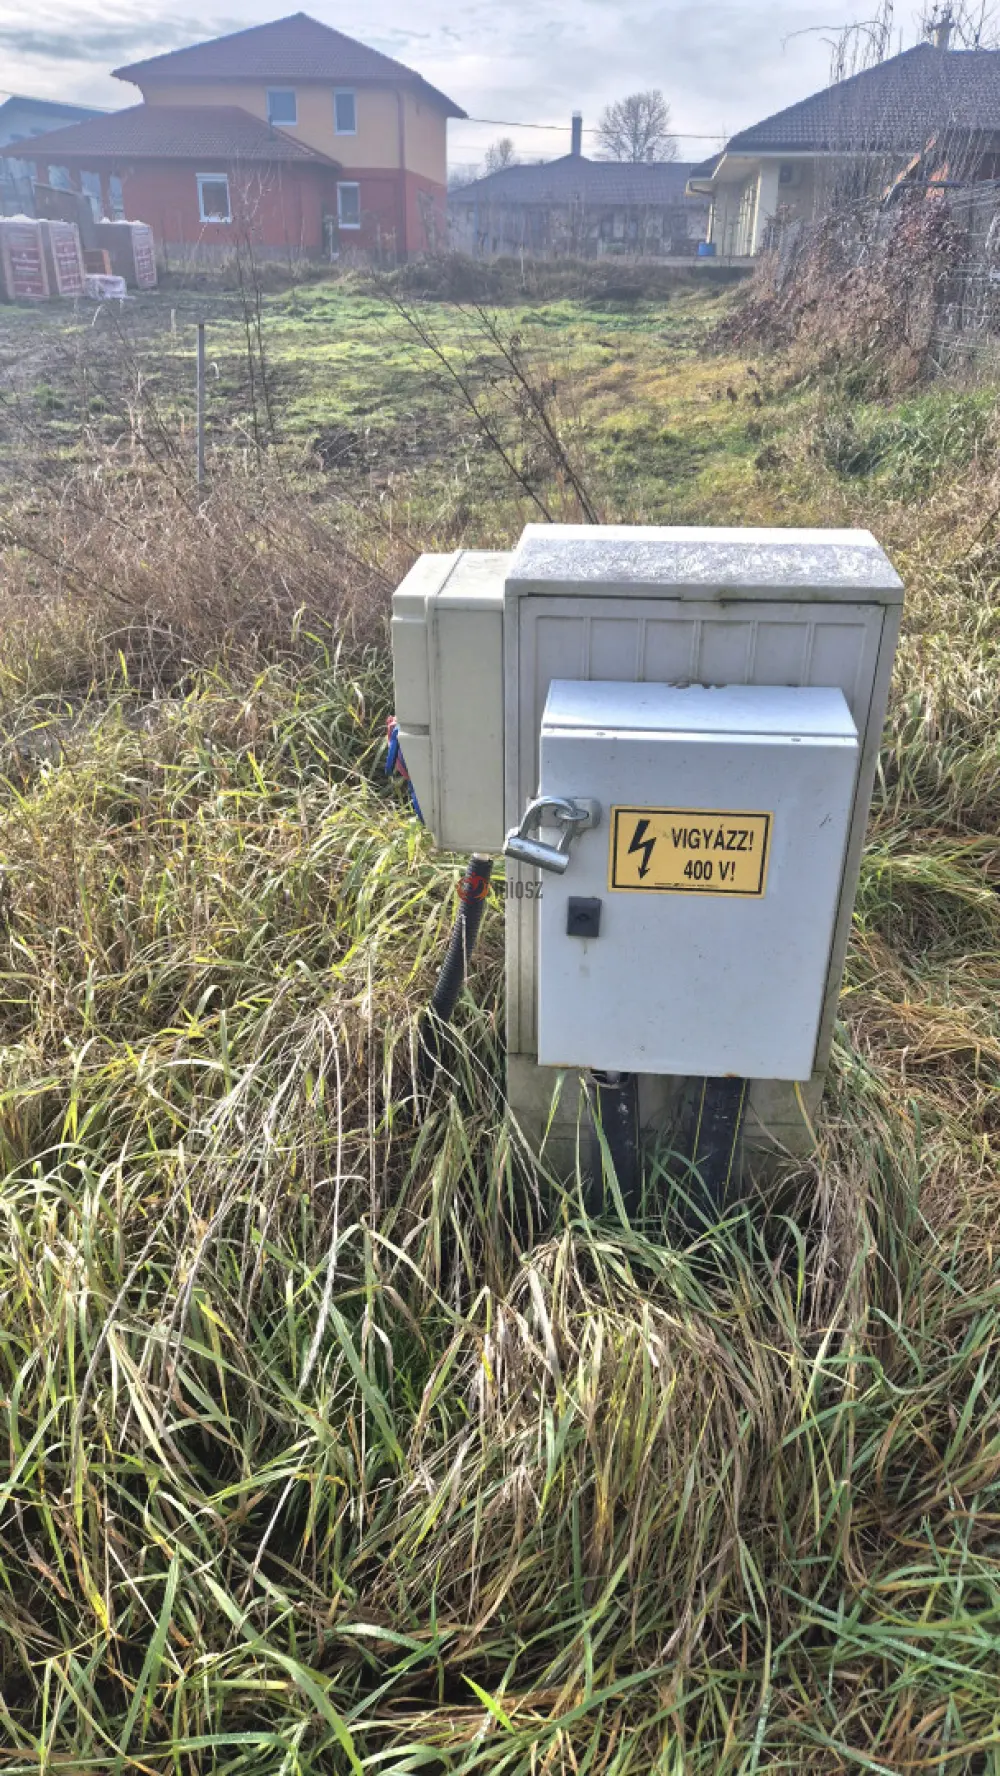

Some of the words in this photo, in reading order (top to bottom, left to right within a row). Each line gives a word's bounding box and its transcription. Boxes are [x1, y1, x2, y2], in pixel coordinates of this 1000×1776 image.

[671, 824, 754, 851] VIGYÁZZ!
[683, 859, 713, 881] 400
[719, 861, 736, 882] V!
